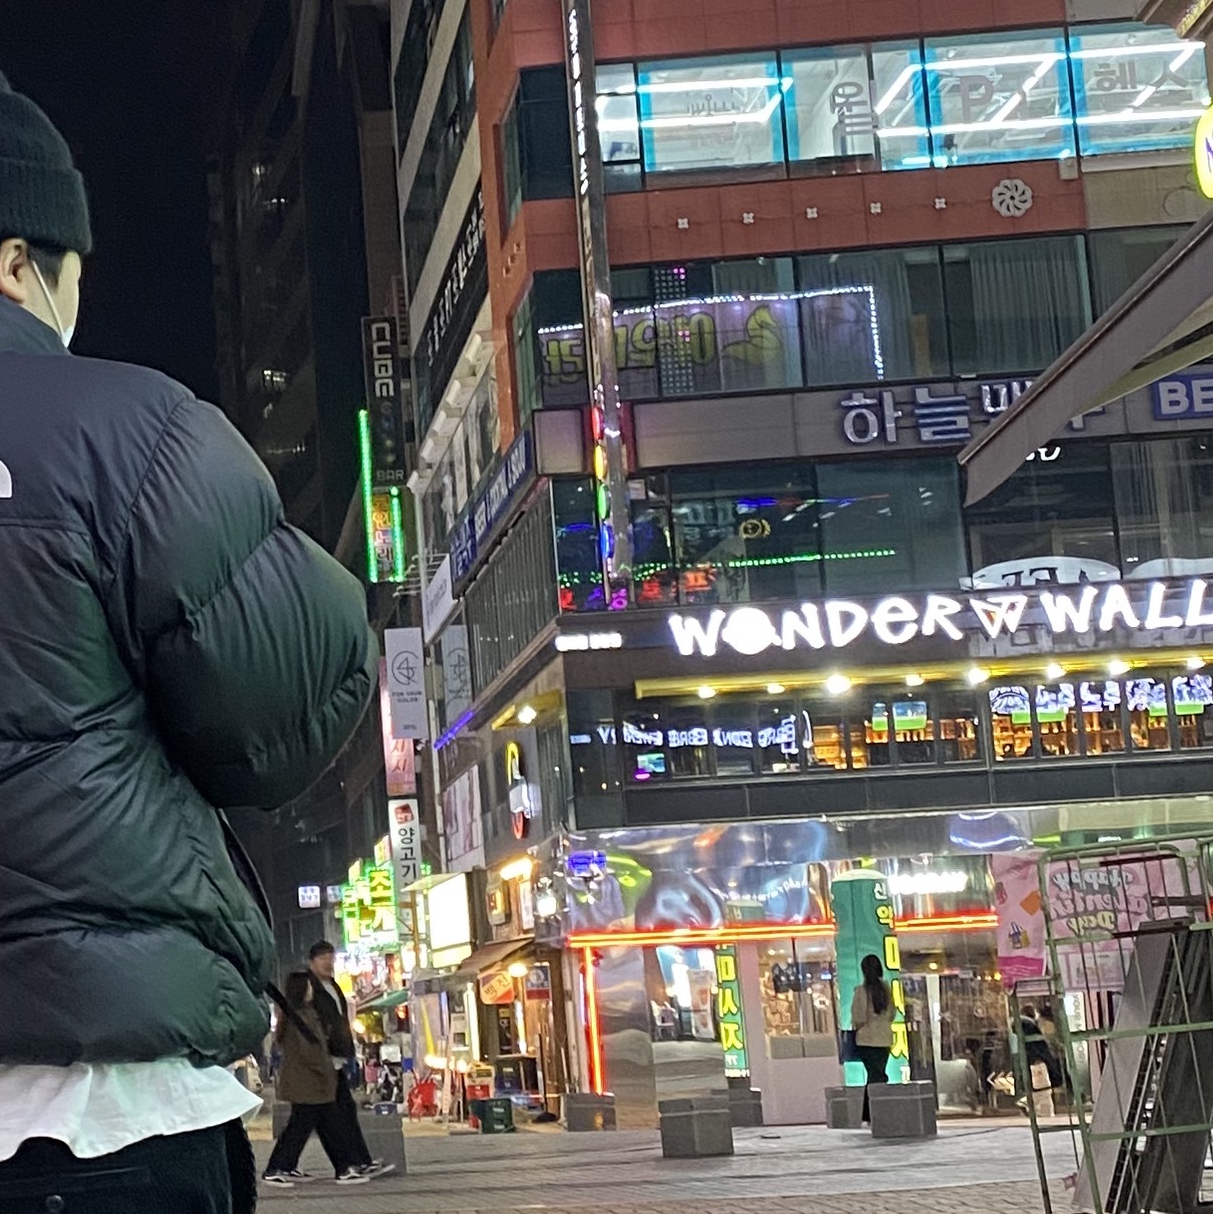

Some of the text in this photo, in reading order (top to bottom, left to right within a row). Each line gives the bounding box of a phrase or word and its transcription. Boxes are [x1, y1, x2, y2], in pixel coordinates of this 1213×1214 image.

[371, 321, 395, 398] CUBE
[841, 378, 1106, 444] 하늘
[376, 470, 405, 482] BAR
[1040, 579, 1213, 633] WALL
